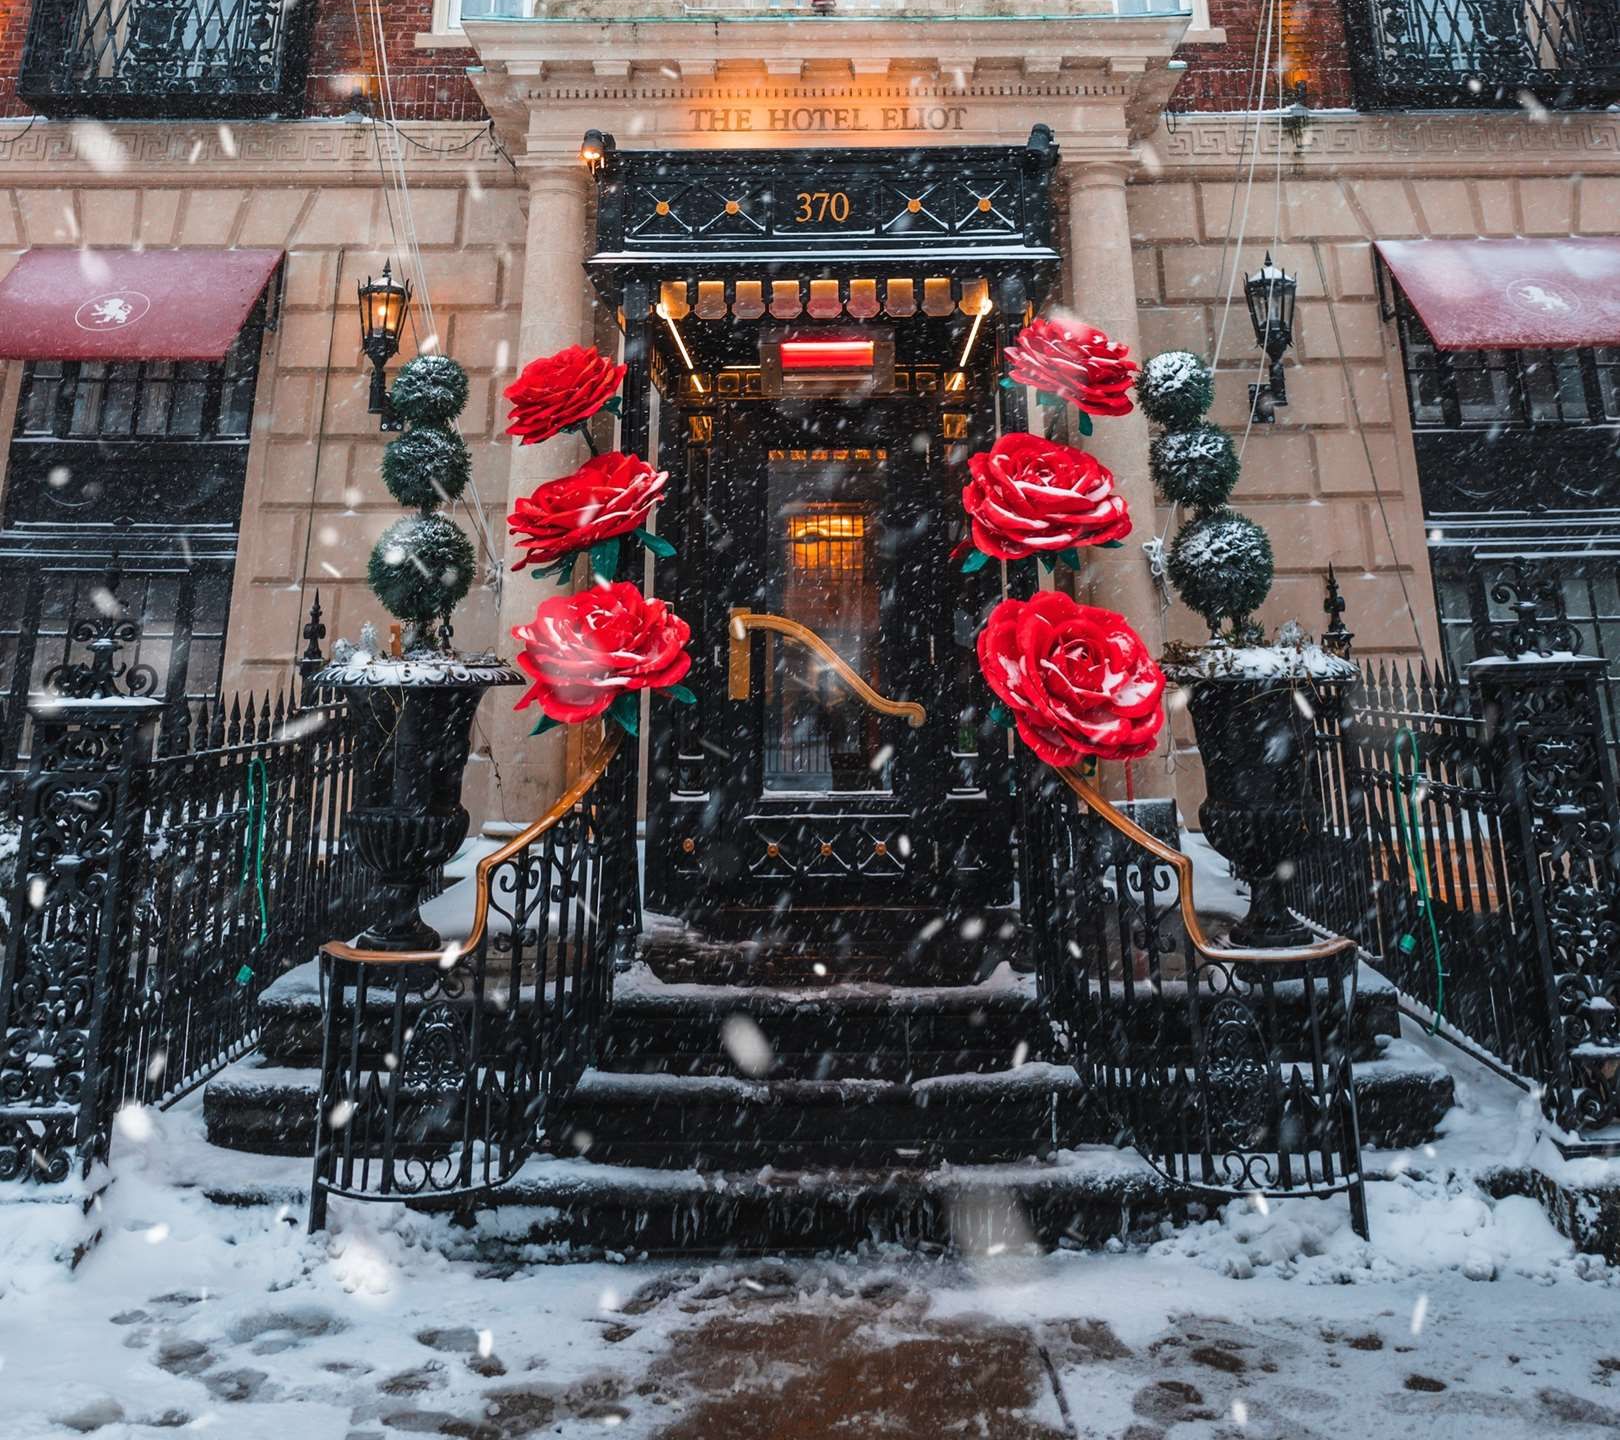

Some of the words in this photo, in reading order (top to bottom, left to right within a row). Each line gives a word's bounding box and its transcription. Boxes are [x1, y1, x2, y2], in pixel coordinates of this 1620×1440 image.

[688, 109, 752, 131] THE
[768, 108, 868, 131] HOTEL
[881, 107, 968, 131] ELIOT
[795, 191, 850, 224] 370
